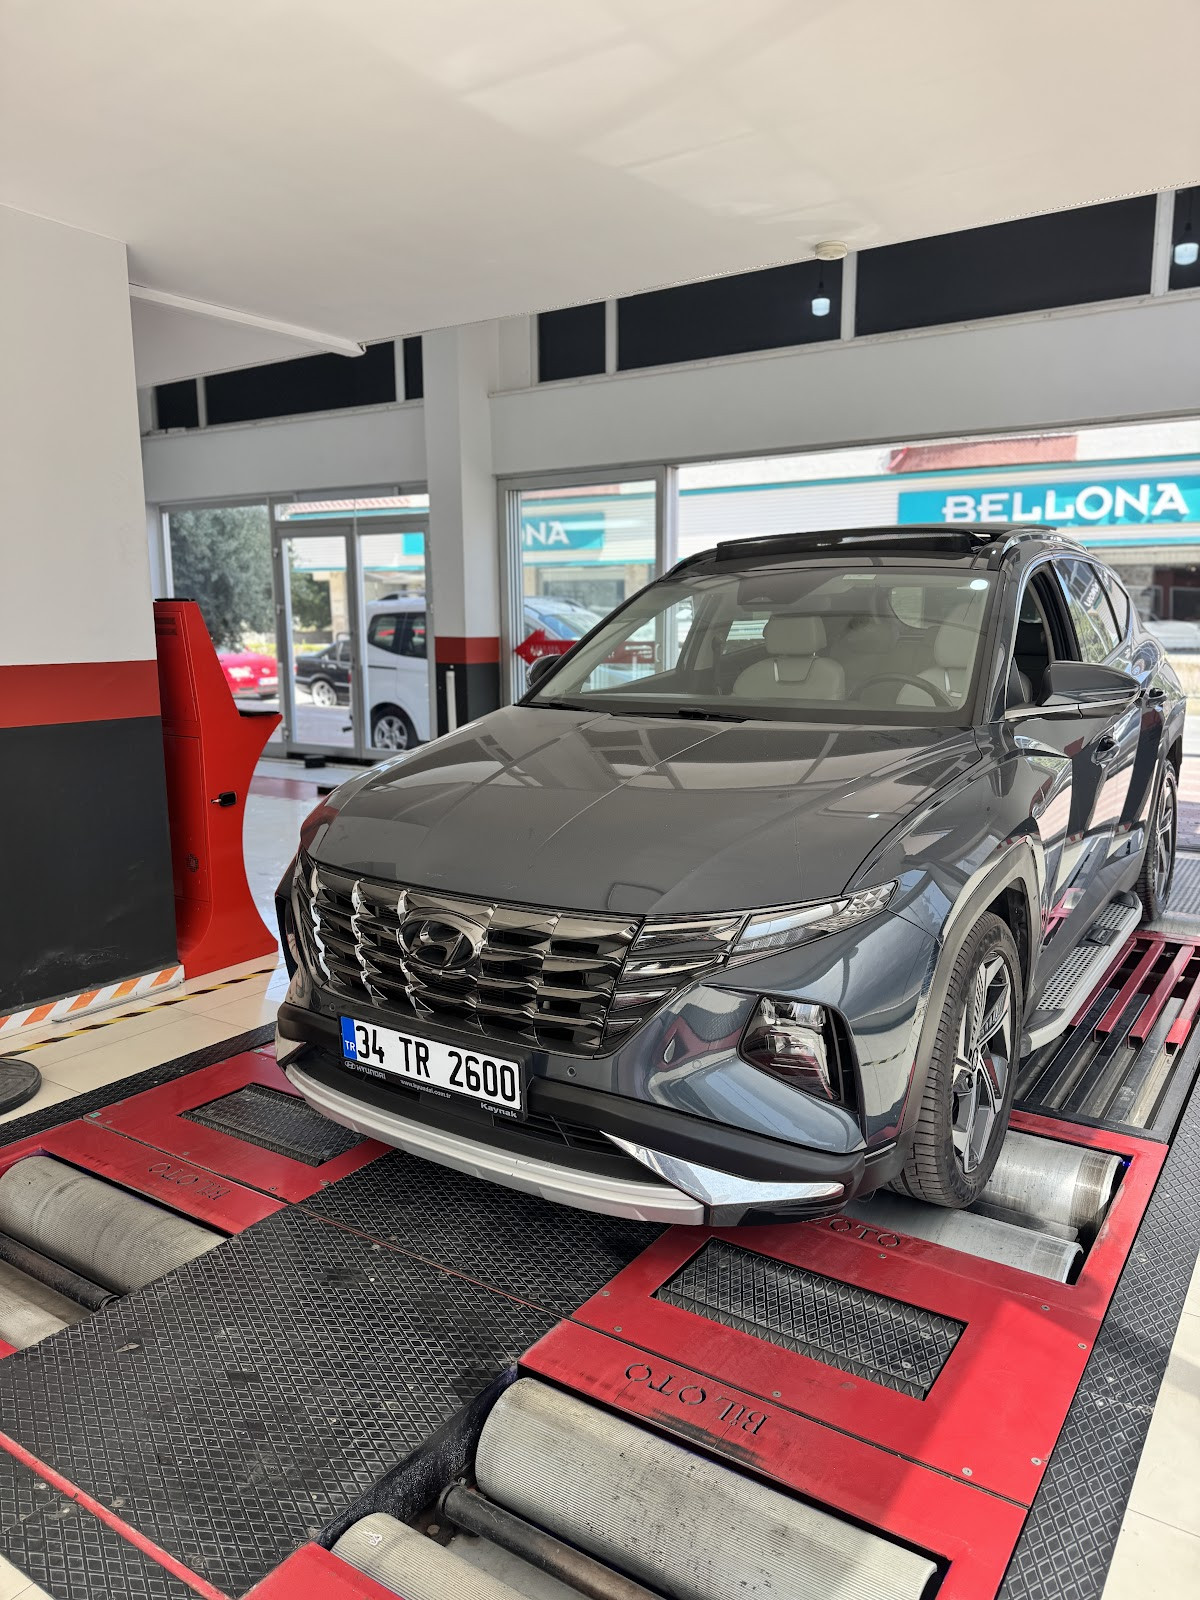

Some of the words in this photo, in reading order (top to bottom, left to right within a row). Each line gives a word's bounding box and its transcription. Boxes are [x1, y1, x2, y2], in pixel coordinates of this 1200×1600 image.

[942, 482, 1190, 523] BELLONA
[522, 521, 570, 546] NA
[344, 1039, 356, 1052] TR
[355, 1025, 385, 1064] 34
[398, 1036, 431, 1079] TR
[448, 1051, 516, 1102] 2600
[355, 1064, 387, 1080] HYUNDAI
[480, 1101, 518, 1119] Kaynak
[829, 1218, 901, 1248] OTO
[624, 1362, 707, 1406] OTO
